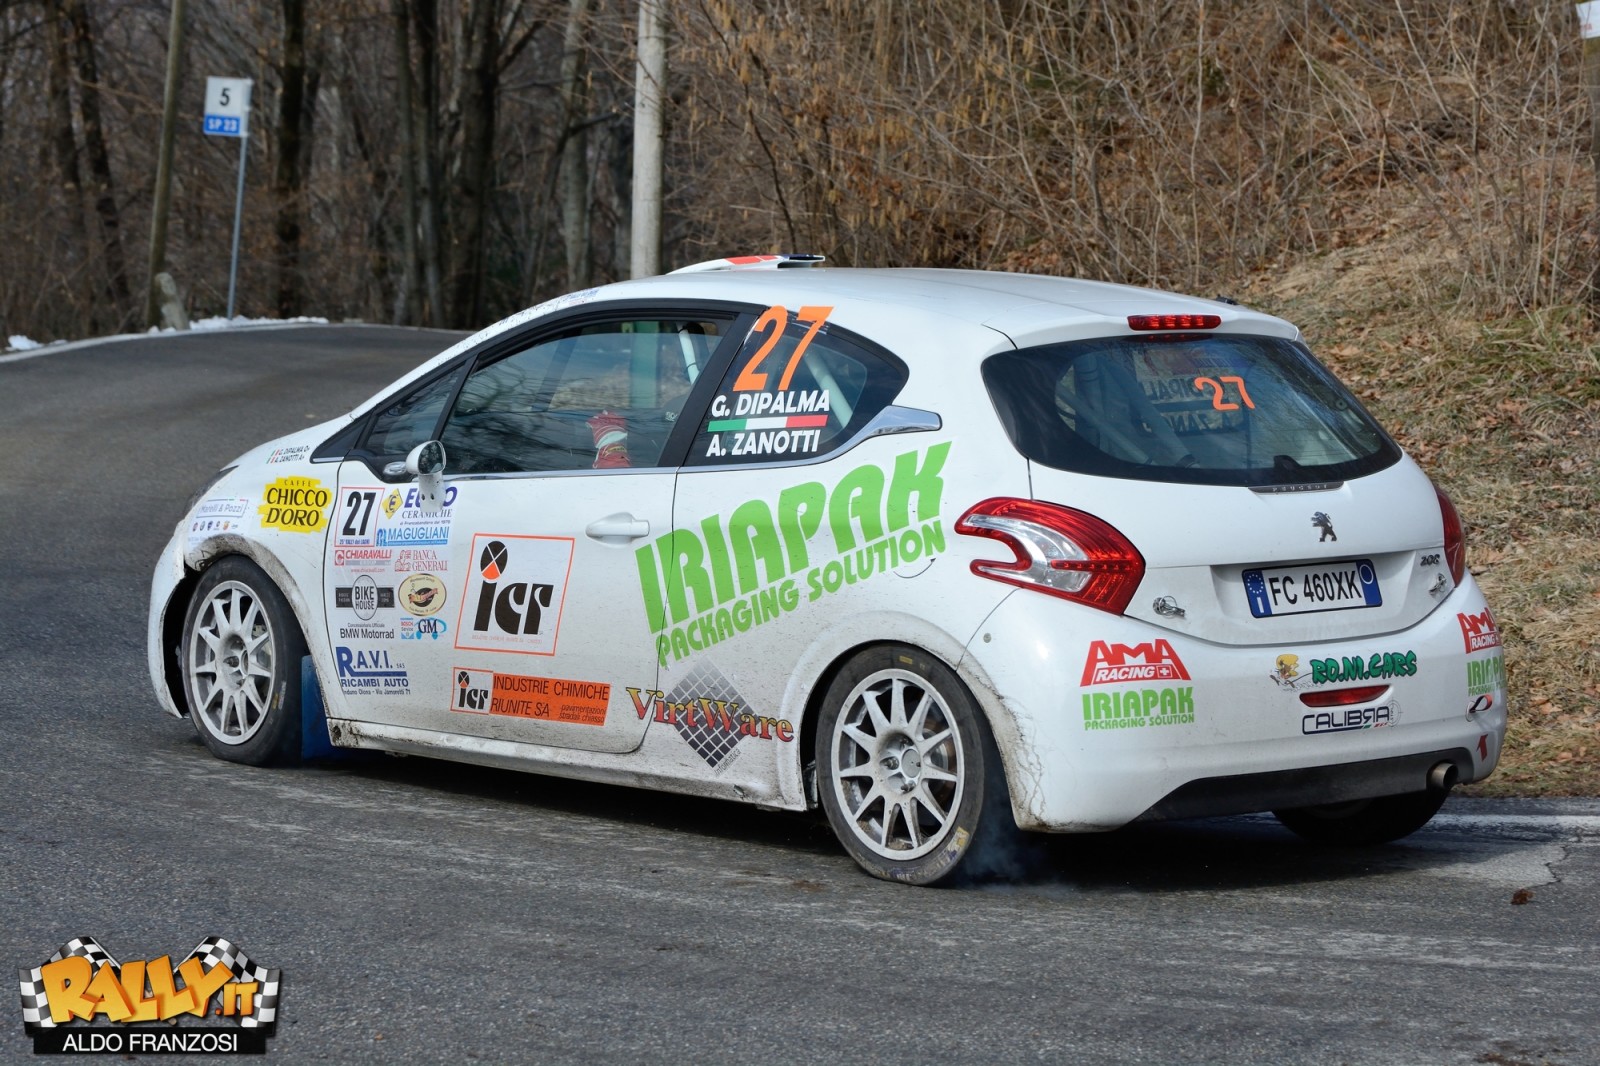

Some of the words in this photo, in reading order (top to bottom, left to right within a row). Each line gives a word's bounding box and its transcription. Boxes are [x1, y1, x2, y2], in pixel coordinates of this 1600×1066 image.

[219, 87, 230, 107] 5
[732, 305, 835, 392] 27
[711, 394, 731, 417] G.
[735, 389, 830, 416] DIPALMA
[1194, 376, 1256, 411] 27
[705, 434, 727, 457] A.
[731, 429, 821, 456] ZANOTTI
[266, 487, 328, 507] CHICCO
[266, 507, 320, 527] D'ORO
[342, 491, 377, 536] 27
[387, 526, 450, 540] MAGUGLIANI
[634, 440, 953, 635] IRIAPAK
[345, 549, 392, 560] CHIARAVALLI
[412, 549, 438, 560] BANCA
[412, 561, 448, 571] GENERALI
[354, 586, 375, 600] BIKE
[654, 578, 800, 670] PACKAGING
[807, 519, 946, 603] SOLUTION
[1268, 575, 1298, 606] FC
[1303, 570, 1362, 602] 460XK
[354, 600, 375, 610] HOUSE
[340, 628, 360, 639] BMW
[361, 628, 395, 639] Motorrad
[418, 618, 438, 634] GM
[1471, 633, 1497, 651] RACING
[335, 646, 393, 677] R.A.V.I.
[1079, 638, 1192, 687] AMA
[1310, 650, 1417, 684] RO.NI.CARS
[341, 678, 380, 688] RICAMBI
[384, 679, 409, 687] AUTO
[1096, 665, 1156, 681] RACING
[493, 676, 550, 695] INDUSTRIE
[553, 681, 610, 700] CHIMICHE
[491, 698, 532, 715] RIUNITE
[1082, 686, 1194, 721] IRIAPAK
[626, 687, 794, 743] VirtWare
[1084, 717, 1146, 731] PACKAGING
[1148, 713, 1195, 727] SOLUTION
[1302, 706, 1390, 735] CALIBRA
